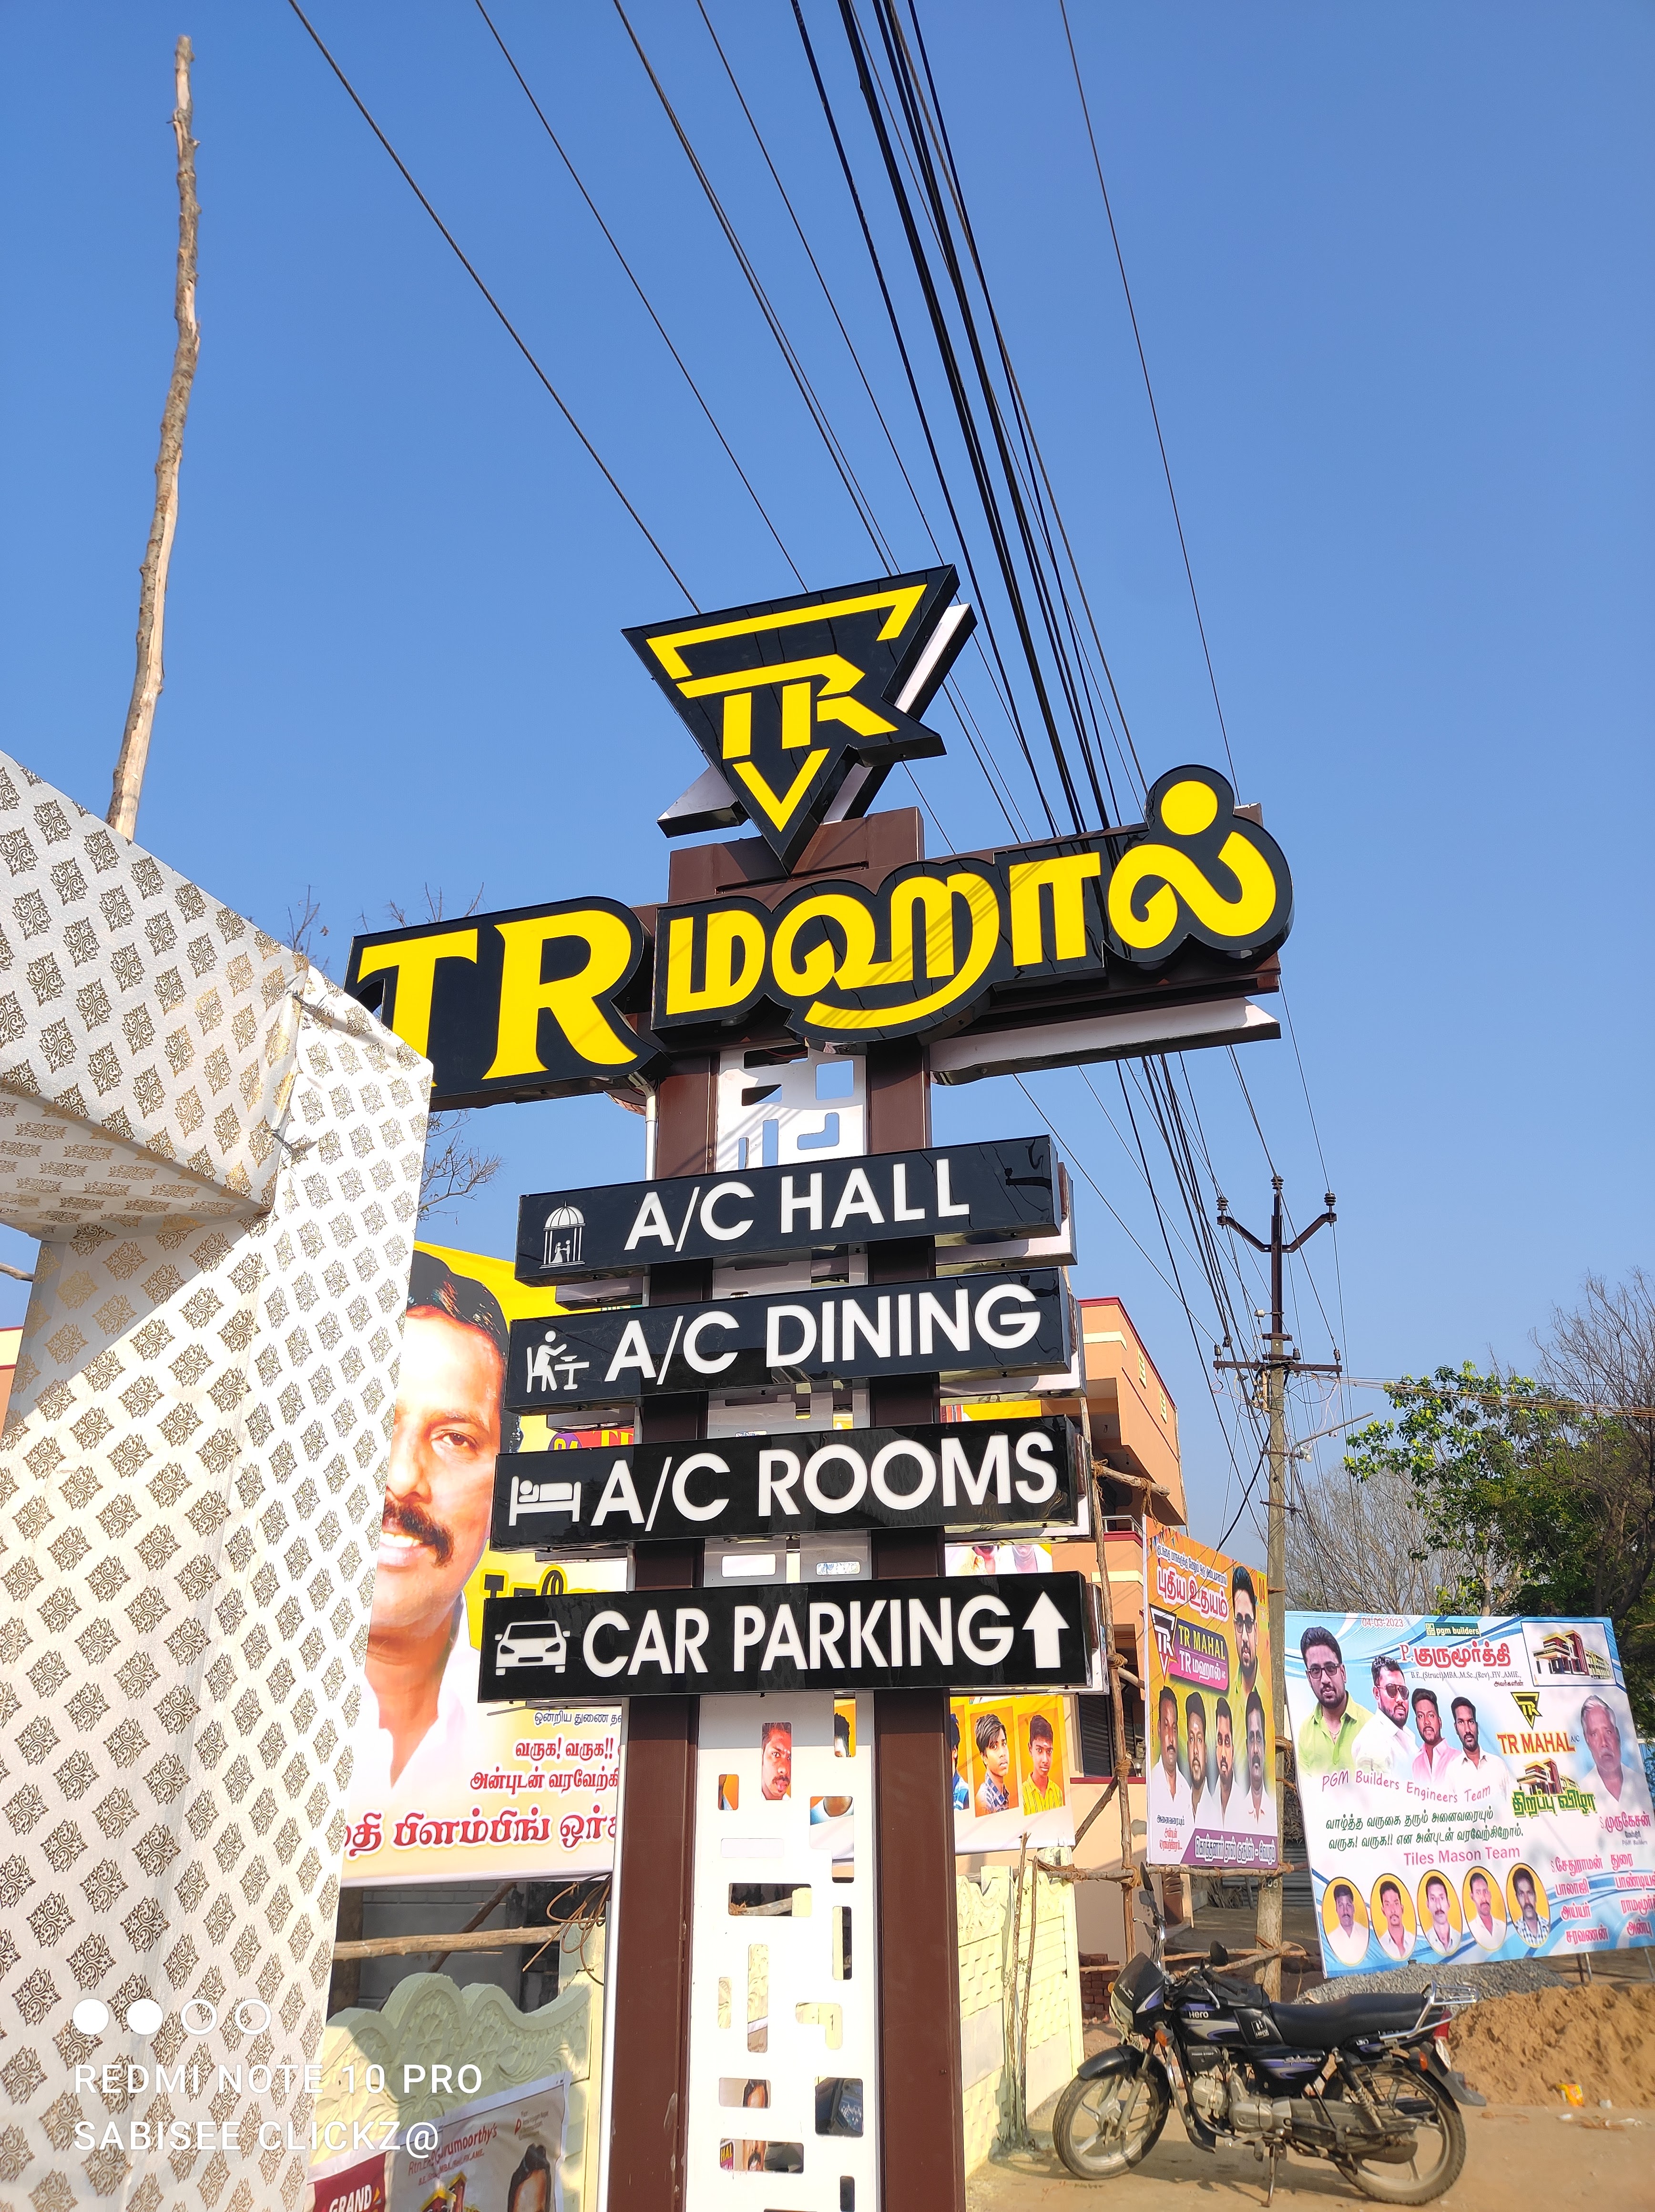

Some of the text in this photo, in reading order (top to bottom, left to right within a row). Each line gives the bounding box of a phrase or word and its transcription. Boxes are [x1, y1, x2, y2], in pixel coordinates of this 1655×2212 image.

[357, 780, 1277, 1088] TR மஹால்
[624, 1159, 970, 1252] A/C HALL
[605, 1283, 1041, 1384] A/C DINING
[591, 1431, 1056, 1531] A/C ROOMS
[1158, 1570, 1185, 1601] புதிய
[1190, 1579, 1228, 1618] உதயம்
[583, 1595, 1013, 1677] CAR PARKING
[1362, 1618, 1404, 1627] 04-03-2023
[1436, 1628, 1451, 1636] pgm
[1452, 1626, 1480, 1635] builders
[1178, 1624, 1226, 1660] TR MAHAL
[1179, 1650, 1192, 1674] TR
[1192, 1658, 1221, 1681] மஹால்
[535, 1710, 572, 1726] ஒன்றிய
[574, 1714, 609, 1725] துணை
[516, 1737, 613, 1761] வருக! வருக!!
[1497, 1733, 1520, 1754] TR
[1521, 1732, 1576, 1753] MAHAL
[470, 1766, 544, 1794] அன்புடன்
[1322, 1771, 1491, 1803] PGM Builders Engineers Team
[1512, 1788, 1597, 1818] திறப்பு விழா
[345, 1813, 382, 1856] தி
[393, 1807, 551, 1846] பிளம்பிங்
[1326, 1805, 1493, 1831] வாழ்த்த வருகை தரும் அனைவரையும்
[1328, 1836, 1358, 1851] வருக!
[1362, 1834, 1393, 1849] வருக!!
[1397, 1834, 1413, 1844] என
[1416, 1827, 1454, 1845] அன்புடன்
[1404, 1846, 1520, 1866] Tiles Mason Team
[1611, 1854, 1634, 1871] துரை
[1555, 1878, 1590, 1895] பாலாஜி
